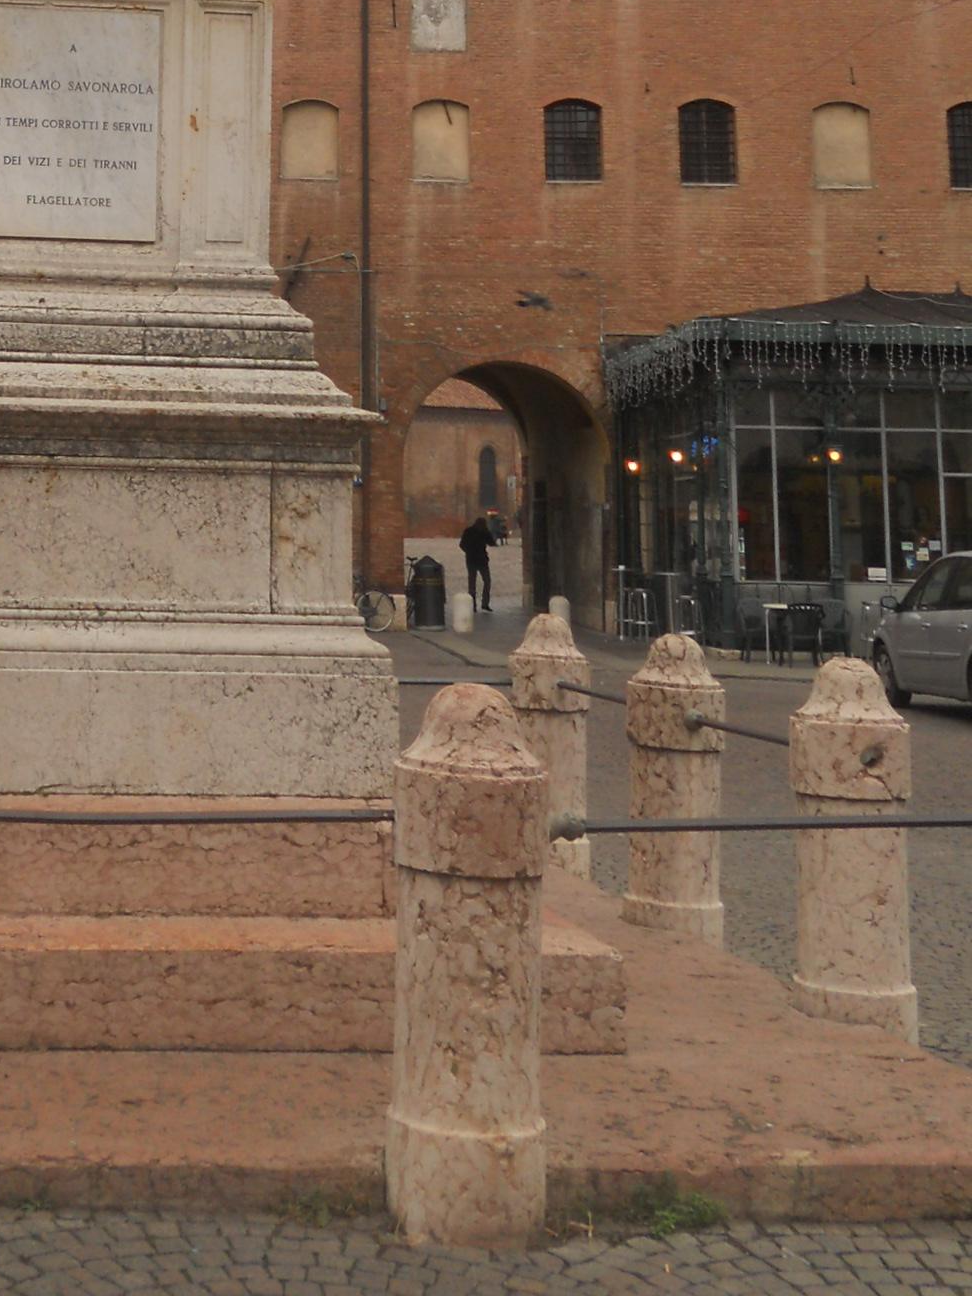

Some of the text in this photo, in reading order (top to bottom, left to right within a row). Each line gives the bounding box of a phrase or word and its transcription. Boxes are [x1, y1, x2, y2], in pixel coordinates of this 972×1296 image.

[69, 44, 77, 53] A
[68, 81, 154, 95] SAVONAROLA
[6, 117, 38, 129] TEMPI
[42, 119, 99, 131] CORROTTI
[103, 121, 109, 131] E
[113, 121, 153, 133] SERVILI
[3, 155, 137, 171] DEI VIZI E DEI TIRANNI
[27, 194, 111, 208] FLAGELLATORE
